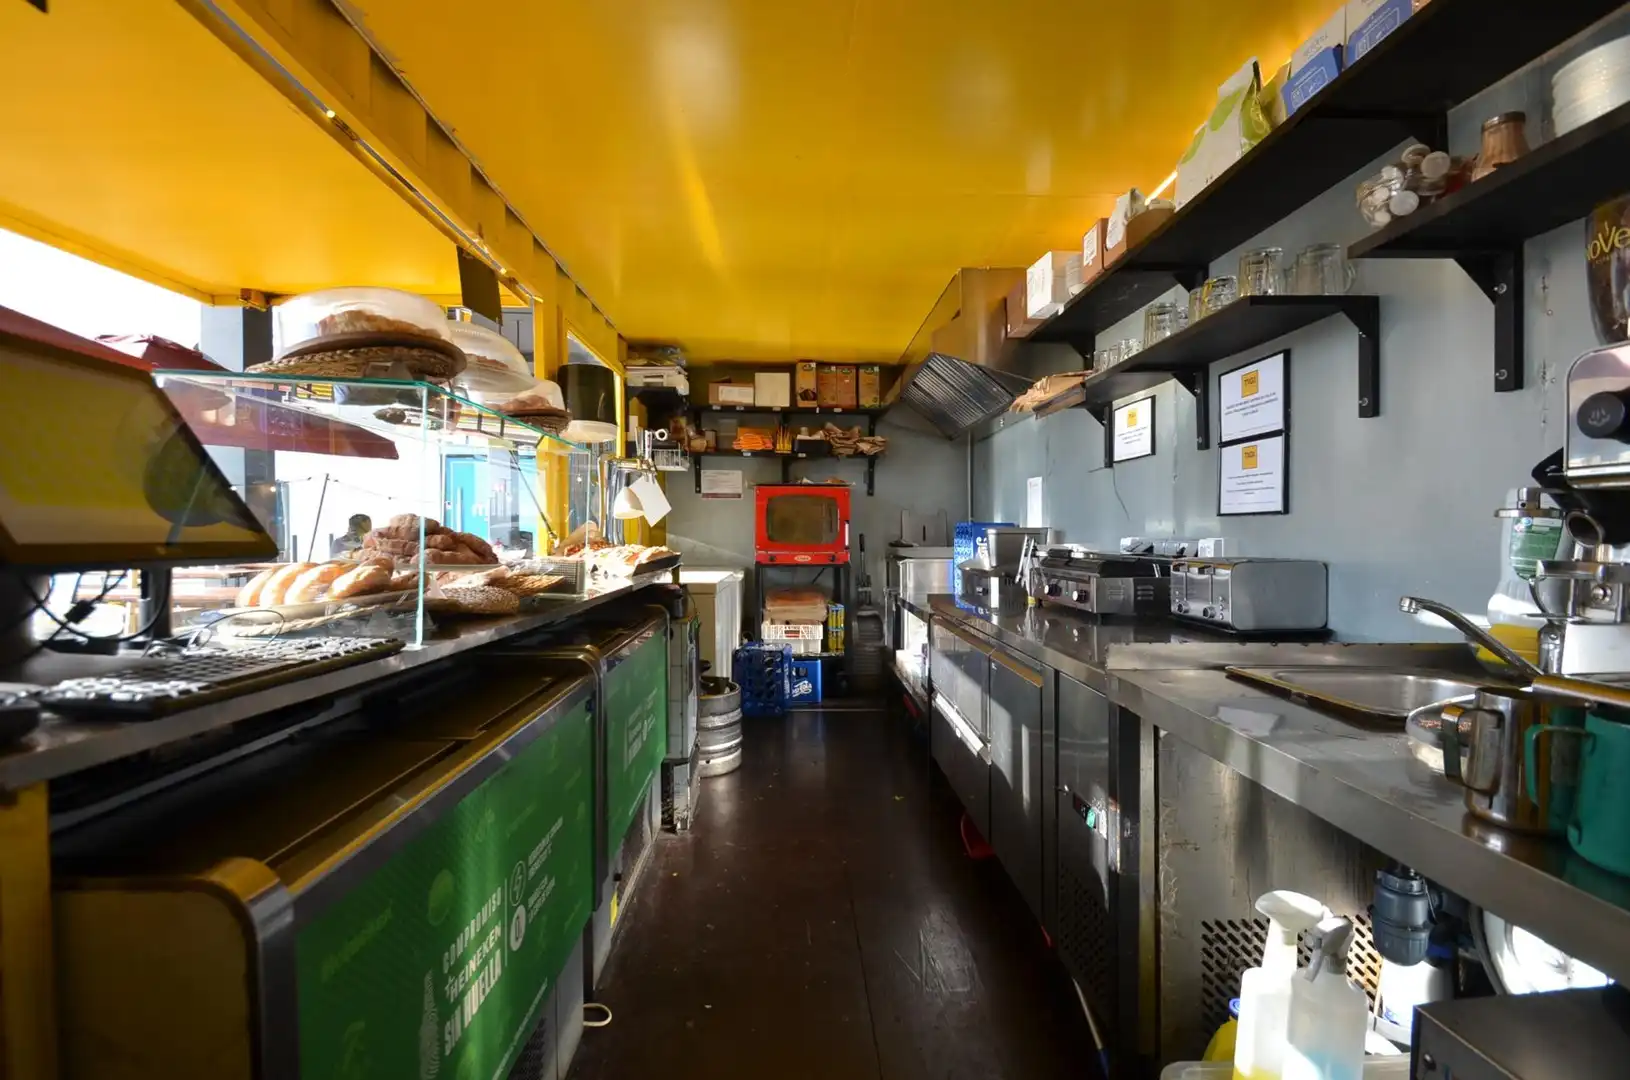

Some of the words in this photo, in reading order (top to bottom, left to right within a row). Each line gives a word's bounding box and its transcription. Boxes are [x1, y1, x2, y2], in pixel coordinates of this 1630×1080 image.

[443, 886, 501, 974] COMPROMISO
[449, 919, 501, 1003] HEINEKEN
[445, 1003, 462, 1056] SIN
[464, 948, 502, 1029] HUELLA
